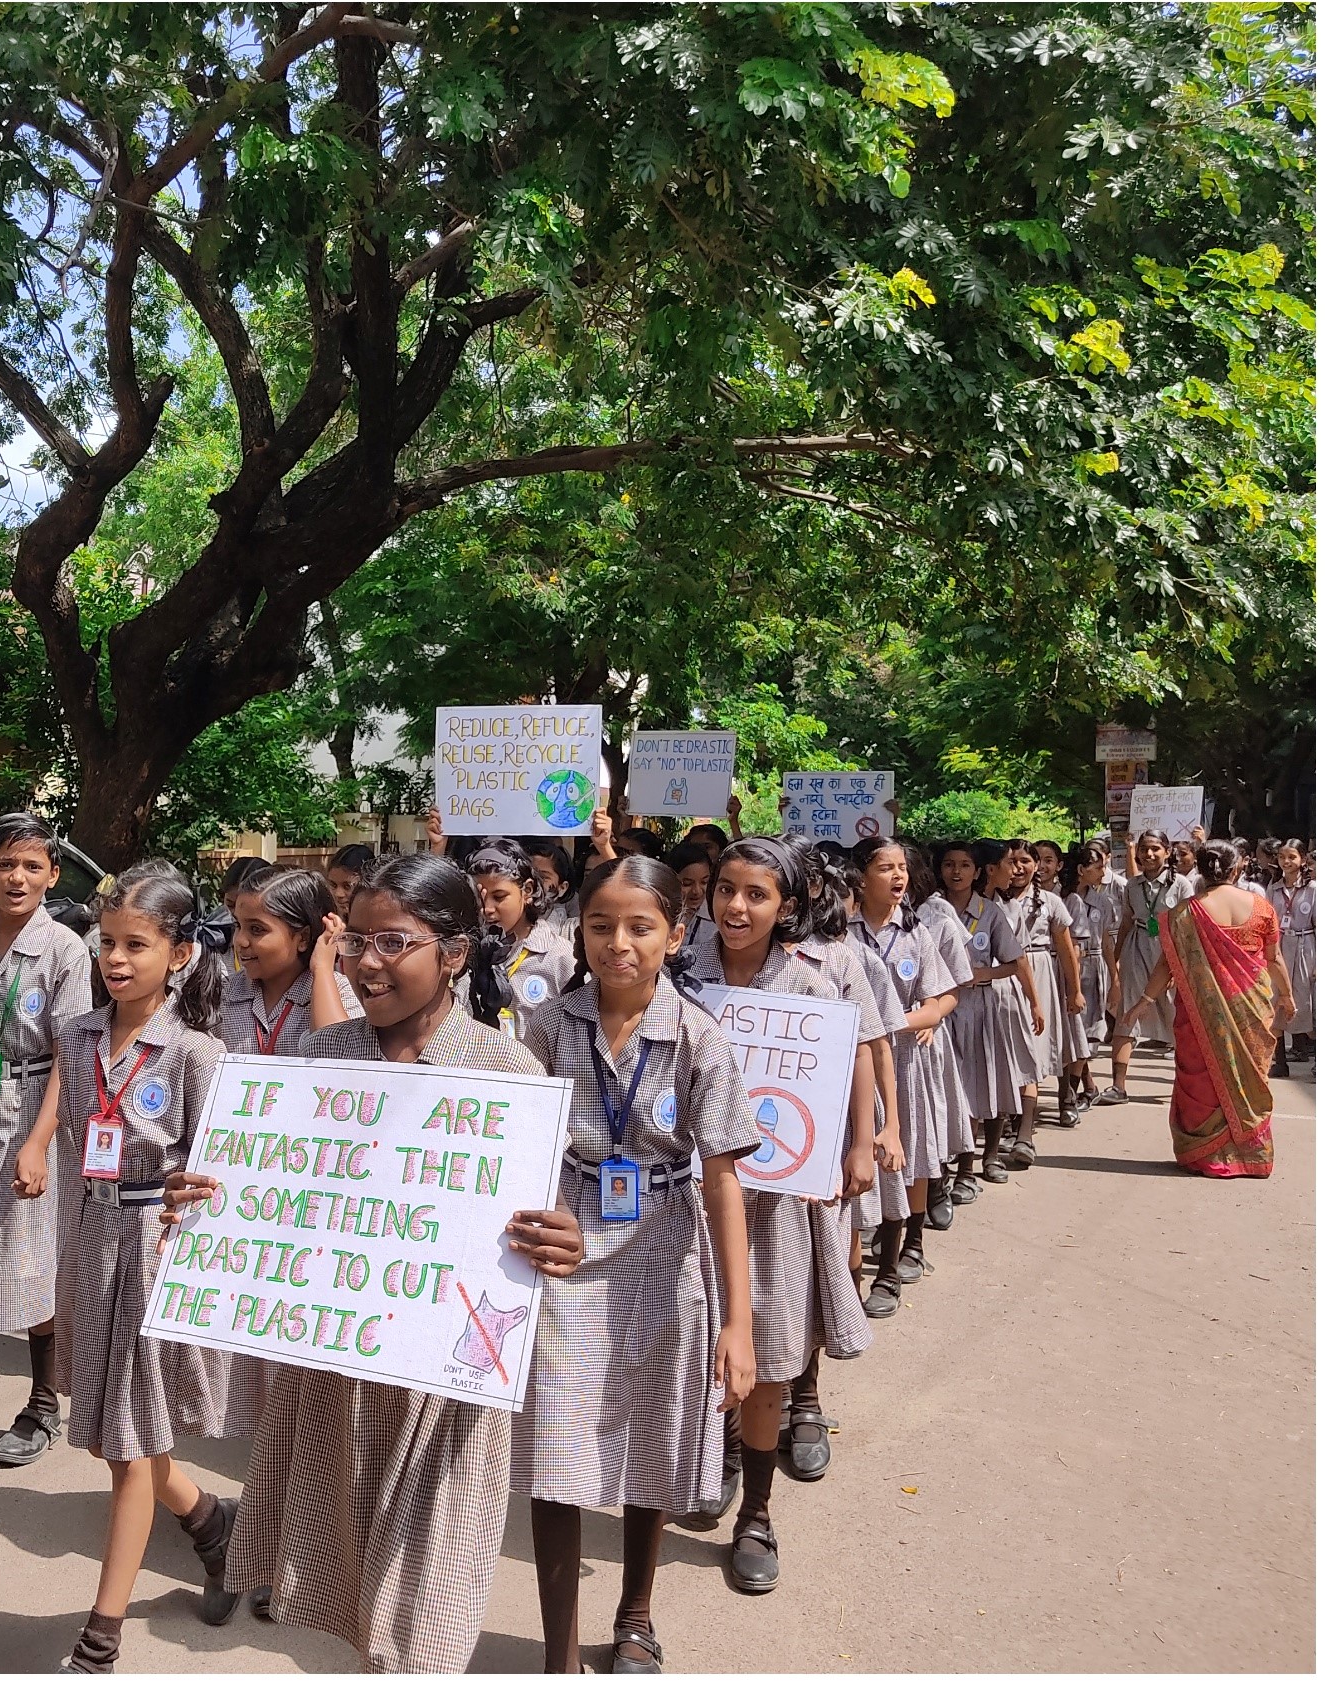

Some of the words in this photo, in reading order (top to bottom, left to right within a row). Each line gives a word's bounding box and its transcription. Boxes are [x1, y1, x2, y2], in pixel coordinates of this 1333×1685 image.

[445, 715, 519, 742] REDUCE,
[518, 713, 595, 740] REFUCE,
[438, 741, 503, 768] REUSE,
[501, 741, 583, 767] RECYCLE
[636, 739, 670, 753] DON'T
[634, 757, 653, 770] SAY
[451, 768, 530, 791] PLASTIC
[850, 778, 866, 789] एक
[873, 773, 885, 791] ही
[447, 794, 499, 822] BAGS.
[718, 1003, 824, 1042] ASTIC
[729, 1042, 818, 1082] TTER
[232, 1080, 284, 1117] IF
[313, 1085, 390, 1126] YOU
[422, 1096, 510, 1139] ARE
[395, 1145, 503, 1197] THEN
[236, 1184, 439, 1243] SOMETHING
[331, 1249, 370, 1292] TO
[382, 1260, 454, 1304] CUT
[160, 1280, 221, 1326] THE
[229, 1292, 394, 1358] 'PLASTIC'
[451, 1377, 484, 1390] PLASTIC
[468, 1369, 485, 1380] USE
